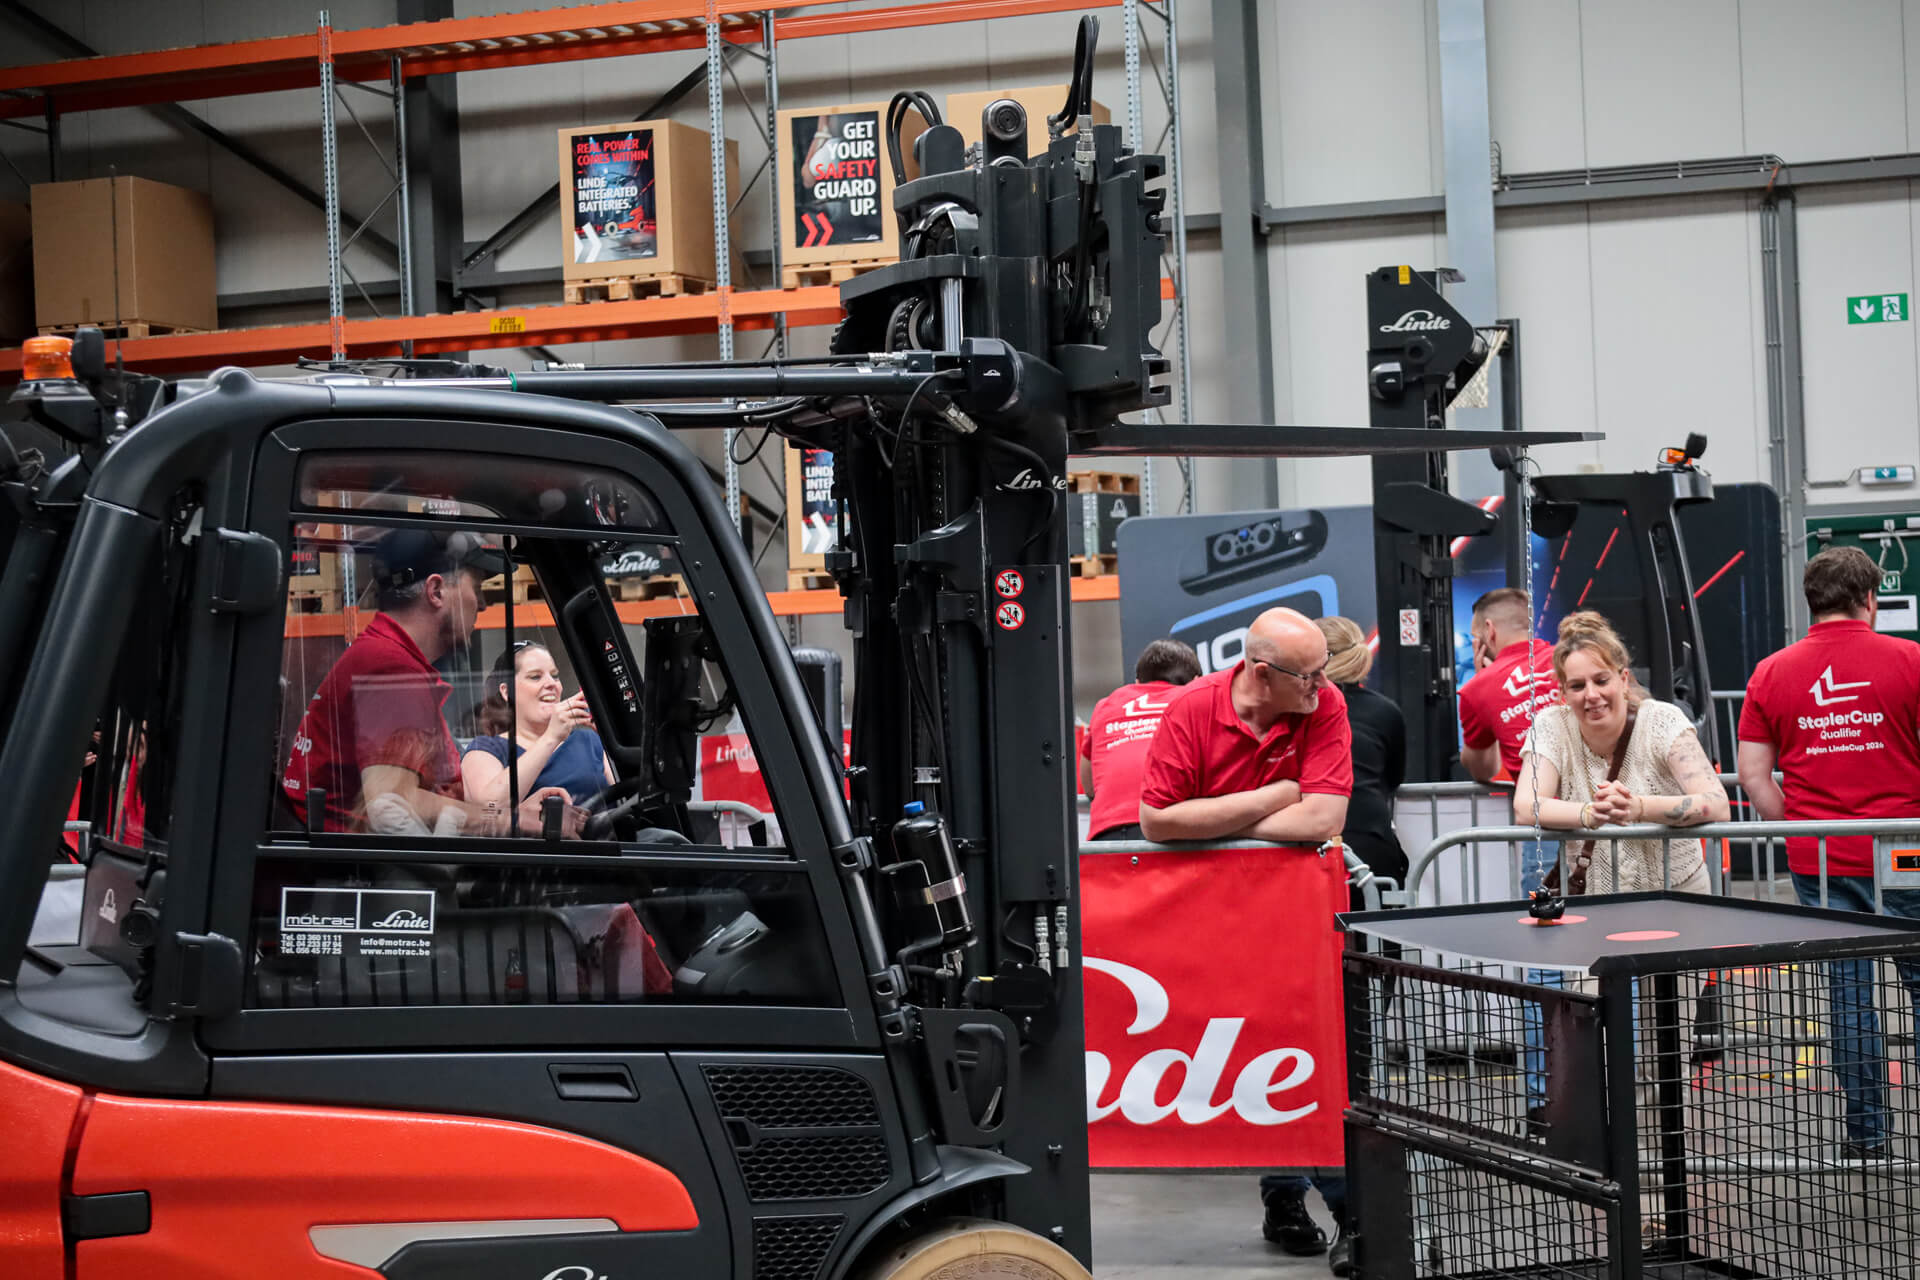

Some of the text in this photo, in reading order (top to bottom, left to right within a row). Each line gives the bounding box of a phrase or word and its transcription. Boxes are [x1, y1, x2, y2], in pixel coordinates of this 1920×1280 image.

[843, 121, 875, 139] GET
[576, 138, 640, 154] REAL POWER
[828, 140, 875, 159] YOUR
[576, 150, 649, 166] COMES WITHIN
[815, 160, 876, 180] SAFETY
[577, 176, 607, 189] LINDE
[814, 179, 876, 199] GUARD
[578, 186, 638, 201] INTEGRATED
[579, 199, 632, 212] BATTERIES.
[850, 198, 877, 216] UP.
[1380, 310, 1450, 332] Linde
[602, 551, 660, 573] Linde
[1797, 710, 1884, 730] StaplerCup
[1820, 728, 1861, 740] Qualifier
[1828, 743, 1865, 753] LindeCup
[286, 909, 430, 929] motrac Linde
[322, 934, 331, 942] 11
[332, 934, 342, 942] 11
[360, 937, 431, 947] info@motrac.be
[360, 948, 430, 956] www.motrac.be
